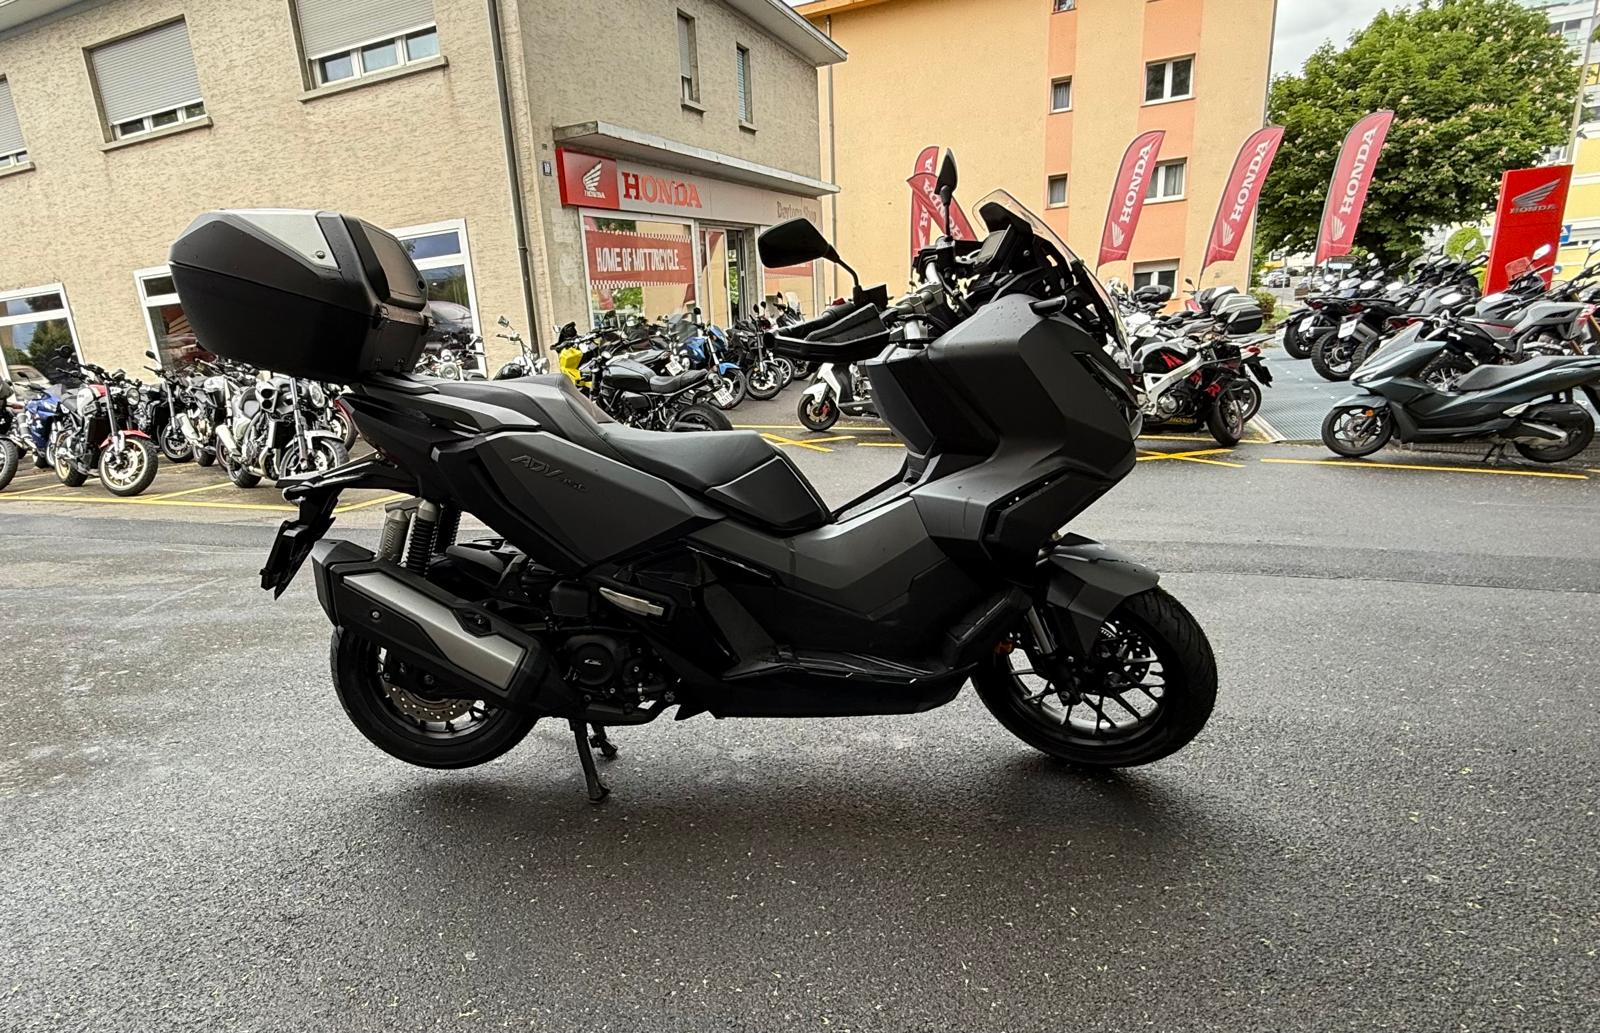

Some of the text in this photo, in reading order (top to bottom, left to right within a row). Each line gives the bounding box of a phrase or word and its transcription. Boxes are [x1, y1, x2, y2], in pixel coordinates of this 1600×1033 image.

[1118, 142, 1152, 223] HONDA
[1229, 139, 1270, 222] HONDA
[1338, 126, 1378, 215] HONDA
[621, 171, 702, 209] HONDA
[1509, 203, 1557, 215] HONDA
[595, 247, 622, 273] HOME
[622, 248, 632, 272] OF
[510, 454, 563, 477] ADV
